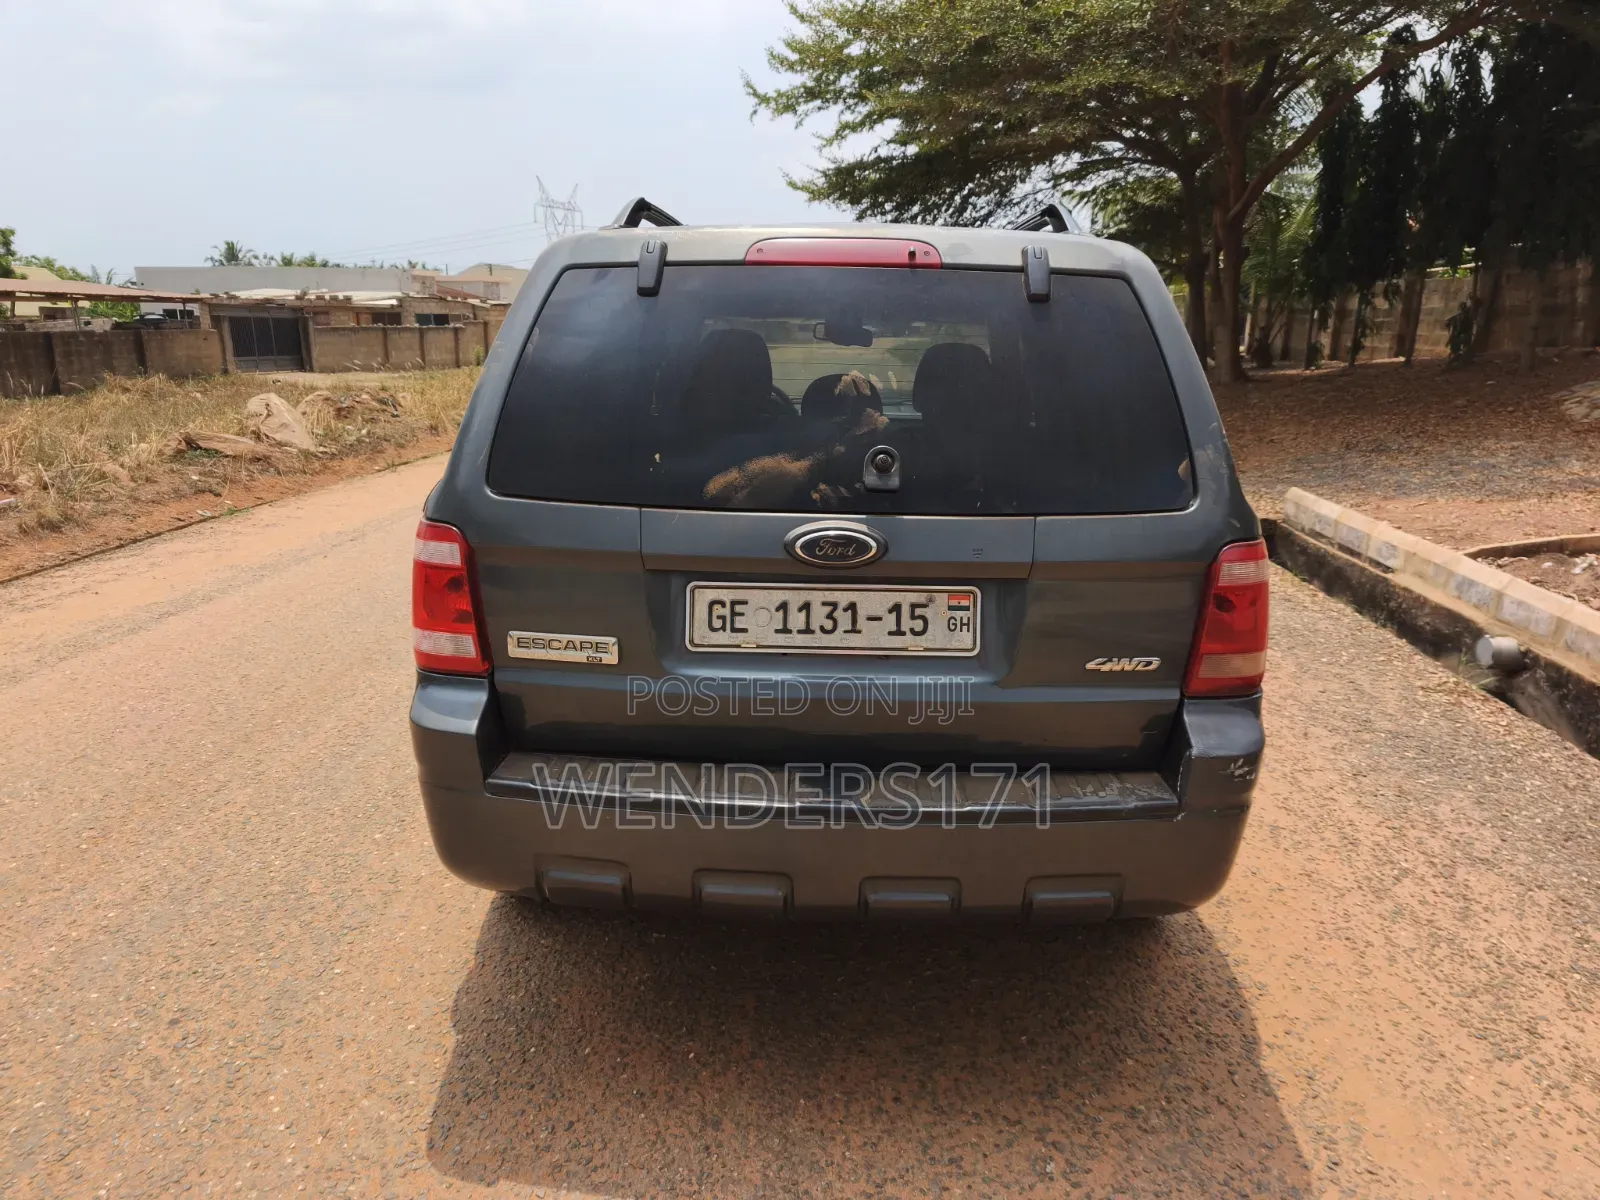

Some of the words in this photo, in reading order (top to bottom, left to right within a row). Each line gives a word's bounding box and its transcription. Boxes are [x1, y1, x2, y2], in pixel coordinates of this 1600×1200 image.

[815, 538, 857, 556] Ford
[707, 599, 749, 634] GE
[774, 600, 930, 637] 1131-15
[947, 616, 971, 633] GH
[516, 637, 609, 654] ESCAPE
[1085, 657, 1161, 672] 4WD
